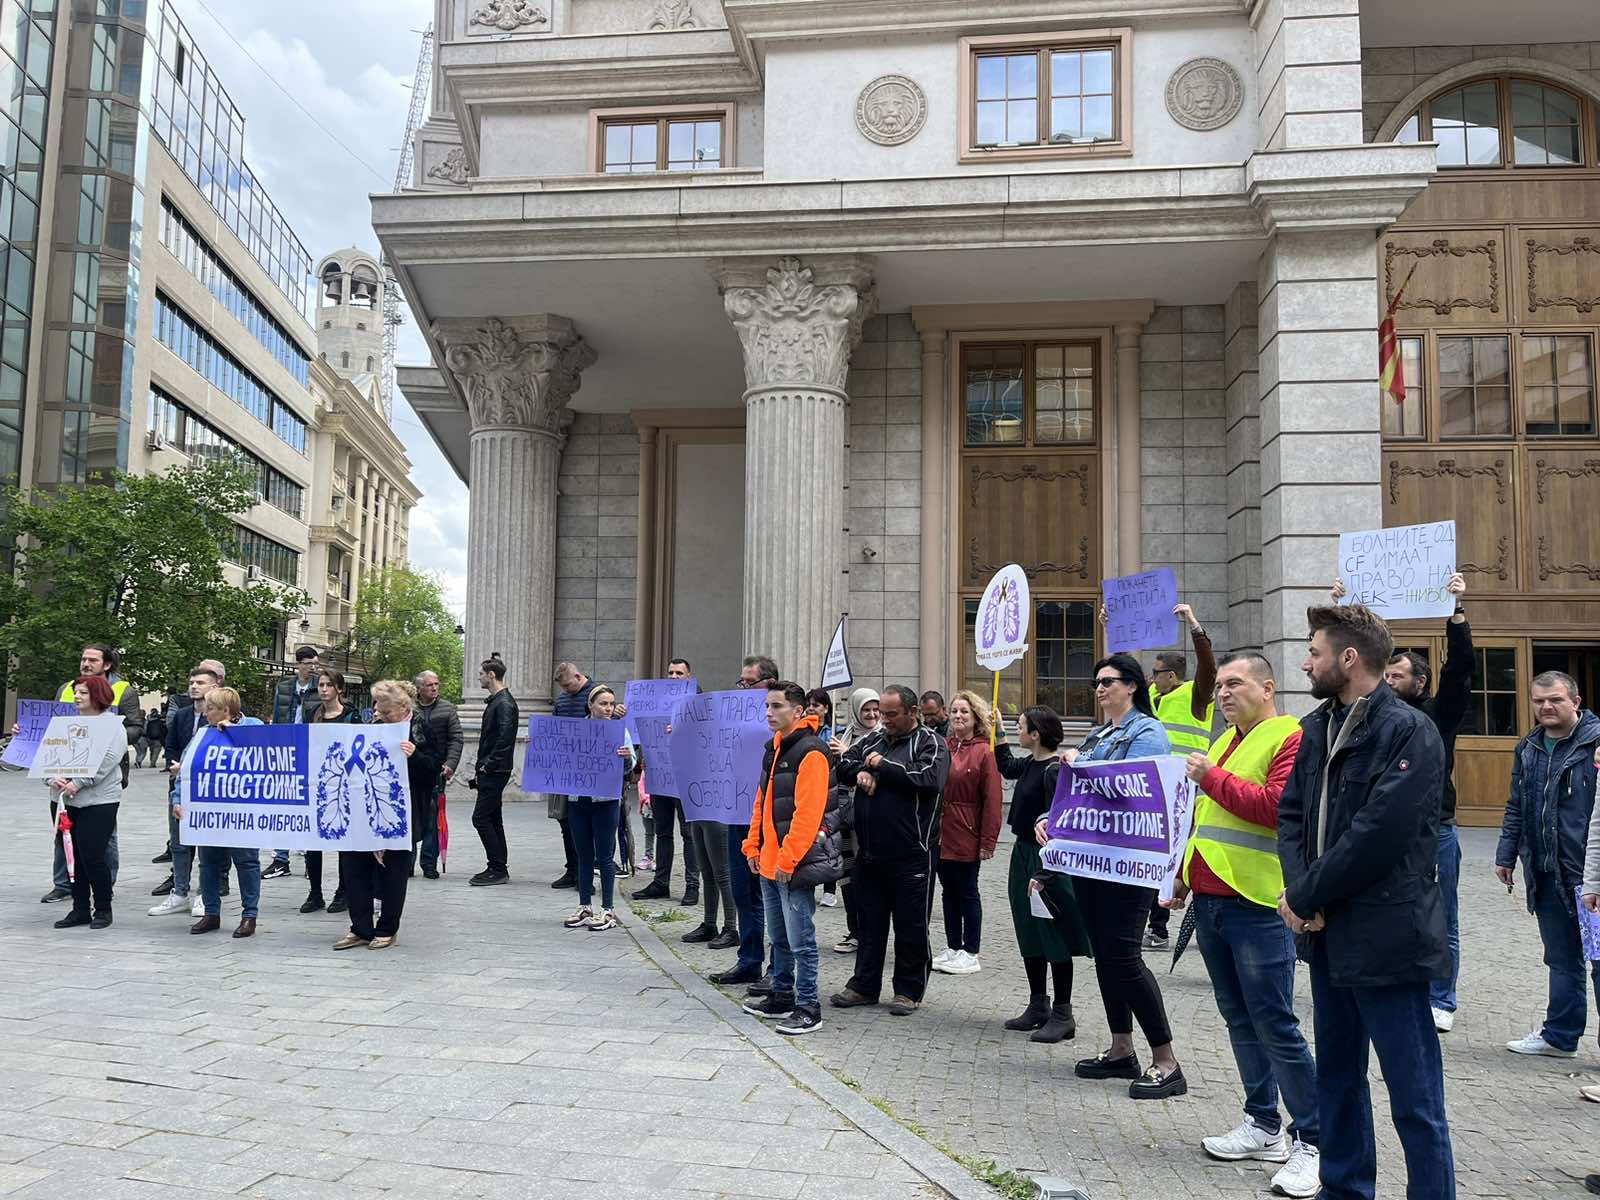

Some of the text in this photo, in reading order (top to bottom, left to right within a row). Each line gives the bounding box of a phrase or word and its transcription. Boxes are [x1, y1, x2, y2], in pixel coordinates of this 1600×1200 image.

[1352, 524, 1455, 553] БОЛНИТЕ ОД
[1375, 545, 1433, 570] ИМААТ
[1350, 564, 1453, 590] ПРАВО НА
[1350, 590, 1388, 604] ЛЕК
[1406, 586, 1452, 604] ЖИВО
[1114, 619, 1165, 644] ДЕЛА
[719, 696, 768, 722] ПРАВО
[204, 745, 296, 772] РЕТКИ СМЕ
[527, 753, 614, 772] НАШАТА БОРБА
[197, 772, 305, 800] И ПОСТОИМЕ
[543, 770, 600, 790] ЗА ЖИВОТ
[1115, 773, 1153, 798] СМЕ
[189, 811, 311, 832] ЦИСТИЧНА ФИБРОЗА
[1072, 806, 1166, 839] ПОСТОИМЕ
[1044, 848, 1112, 875] ЦИСТИЧНА
